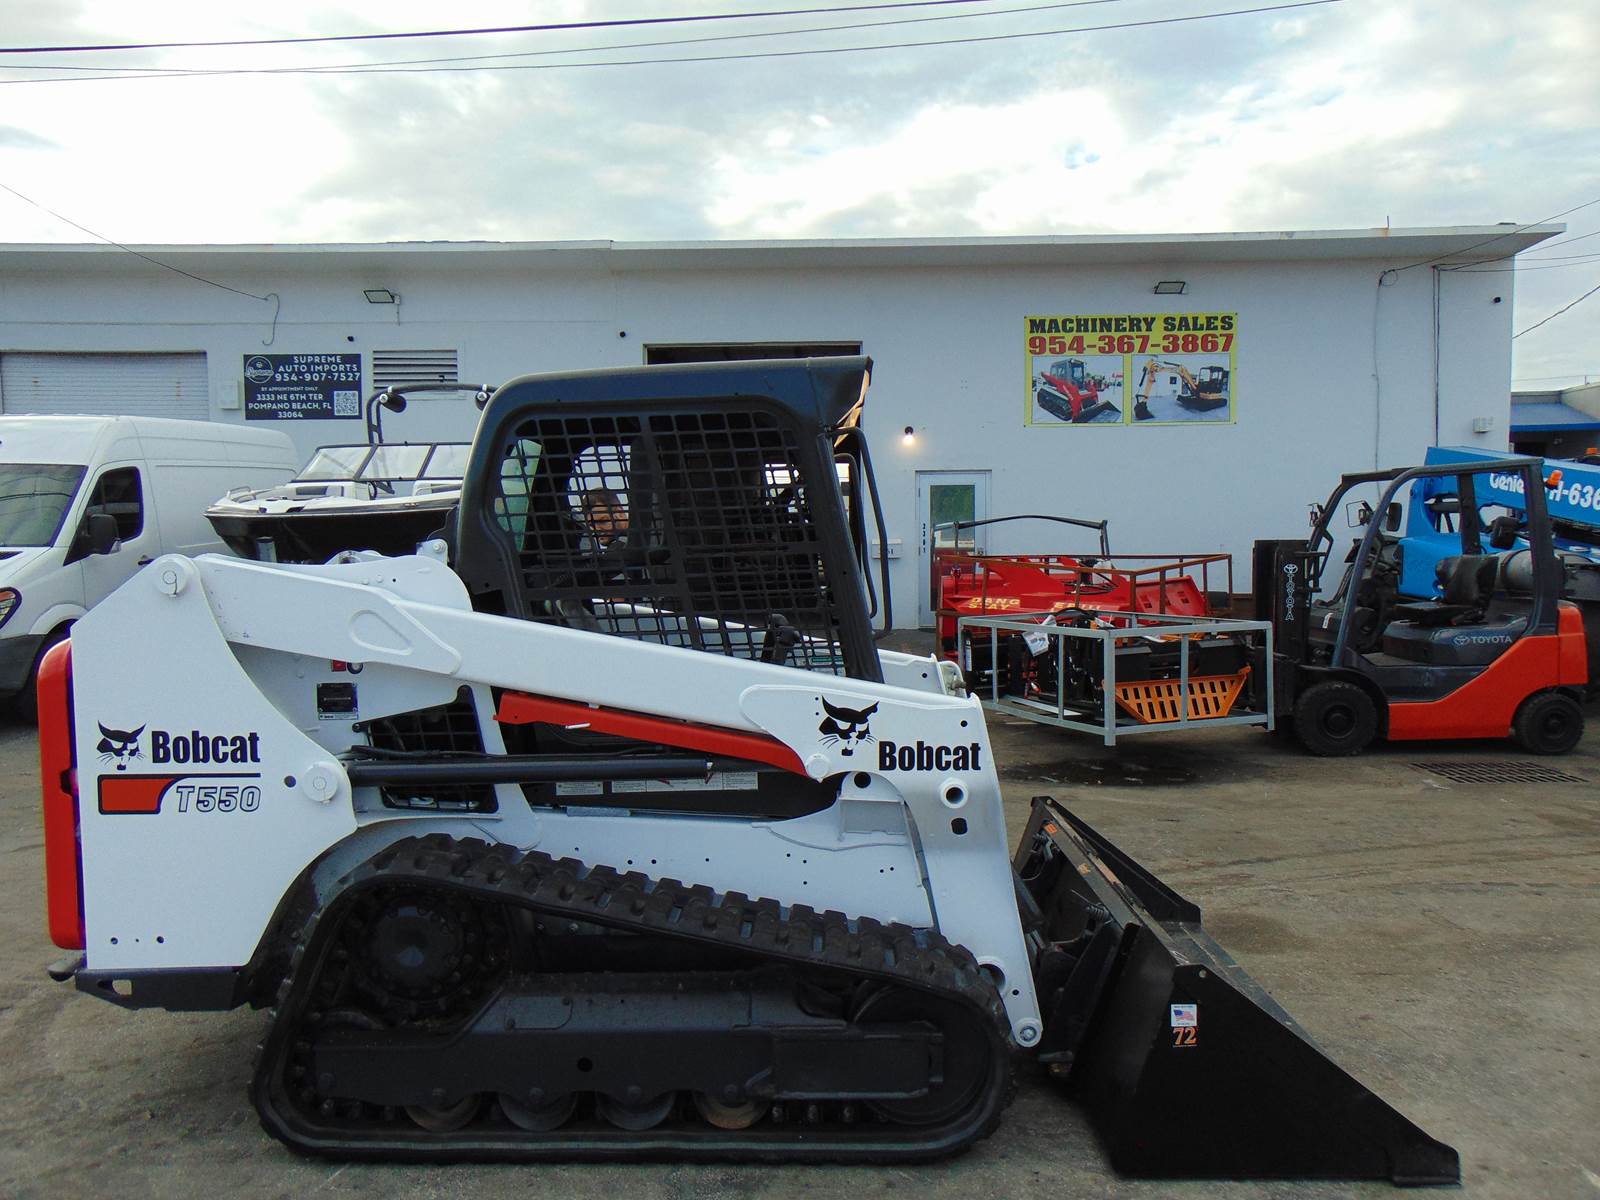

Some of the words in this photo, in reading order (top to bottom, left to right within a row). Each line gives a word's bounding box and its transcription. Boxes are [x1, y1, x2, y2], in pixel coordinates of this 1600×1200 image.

[1029, 316, 1156, 334] MACHINERY
[1163, 315, 1233, 332] SALES
[1029, 333, 1234, 355] 954-367-3867
[278, 364, 307, 372] AUTO
[310, 364, 358, 372] IMPORTS
[293, 355, 342, 363] SUPREME
[274, 372, 361, 381] 954-907-7527
[248, 402, 290, 410] POMPANO
[291, 402, 321, 410] BEACH,
[256, 393, 275, 401] 3333
[276, 393, 288, 401] NE
[289, 393, 307, 401] 6TH
[307, 393, 324, 401] TER
[1285, 573, 1295, 621] TOYOTA
[1470, 635, 1513, 644] TOYOTA
[151, 730, 261, 764] Bobcat
[878, 741, 981, 771] Bobcat
[176, 785, 261, 813] T550
[1172, 1027, 1197, 1045] 72
